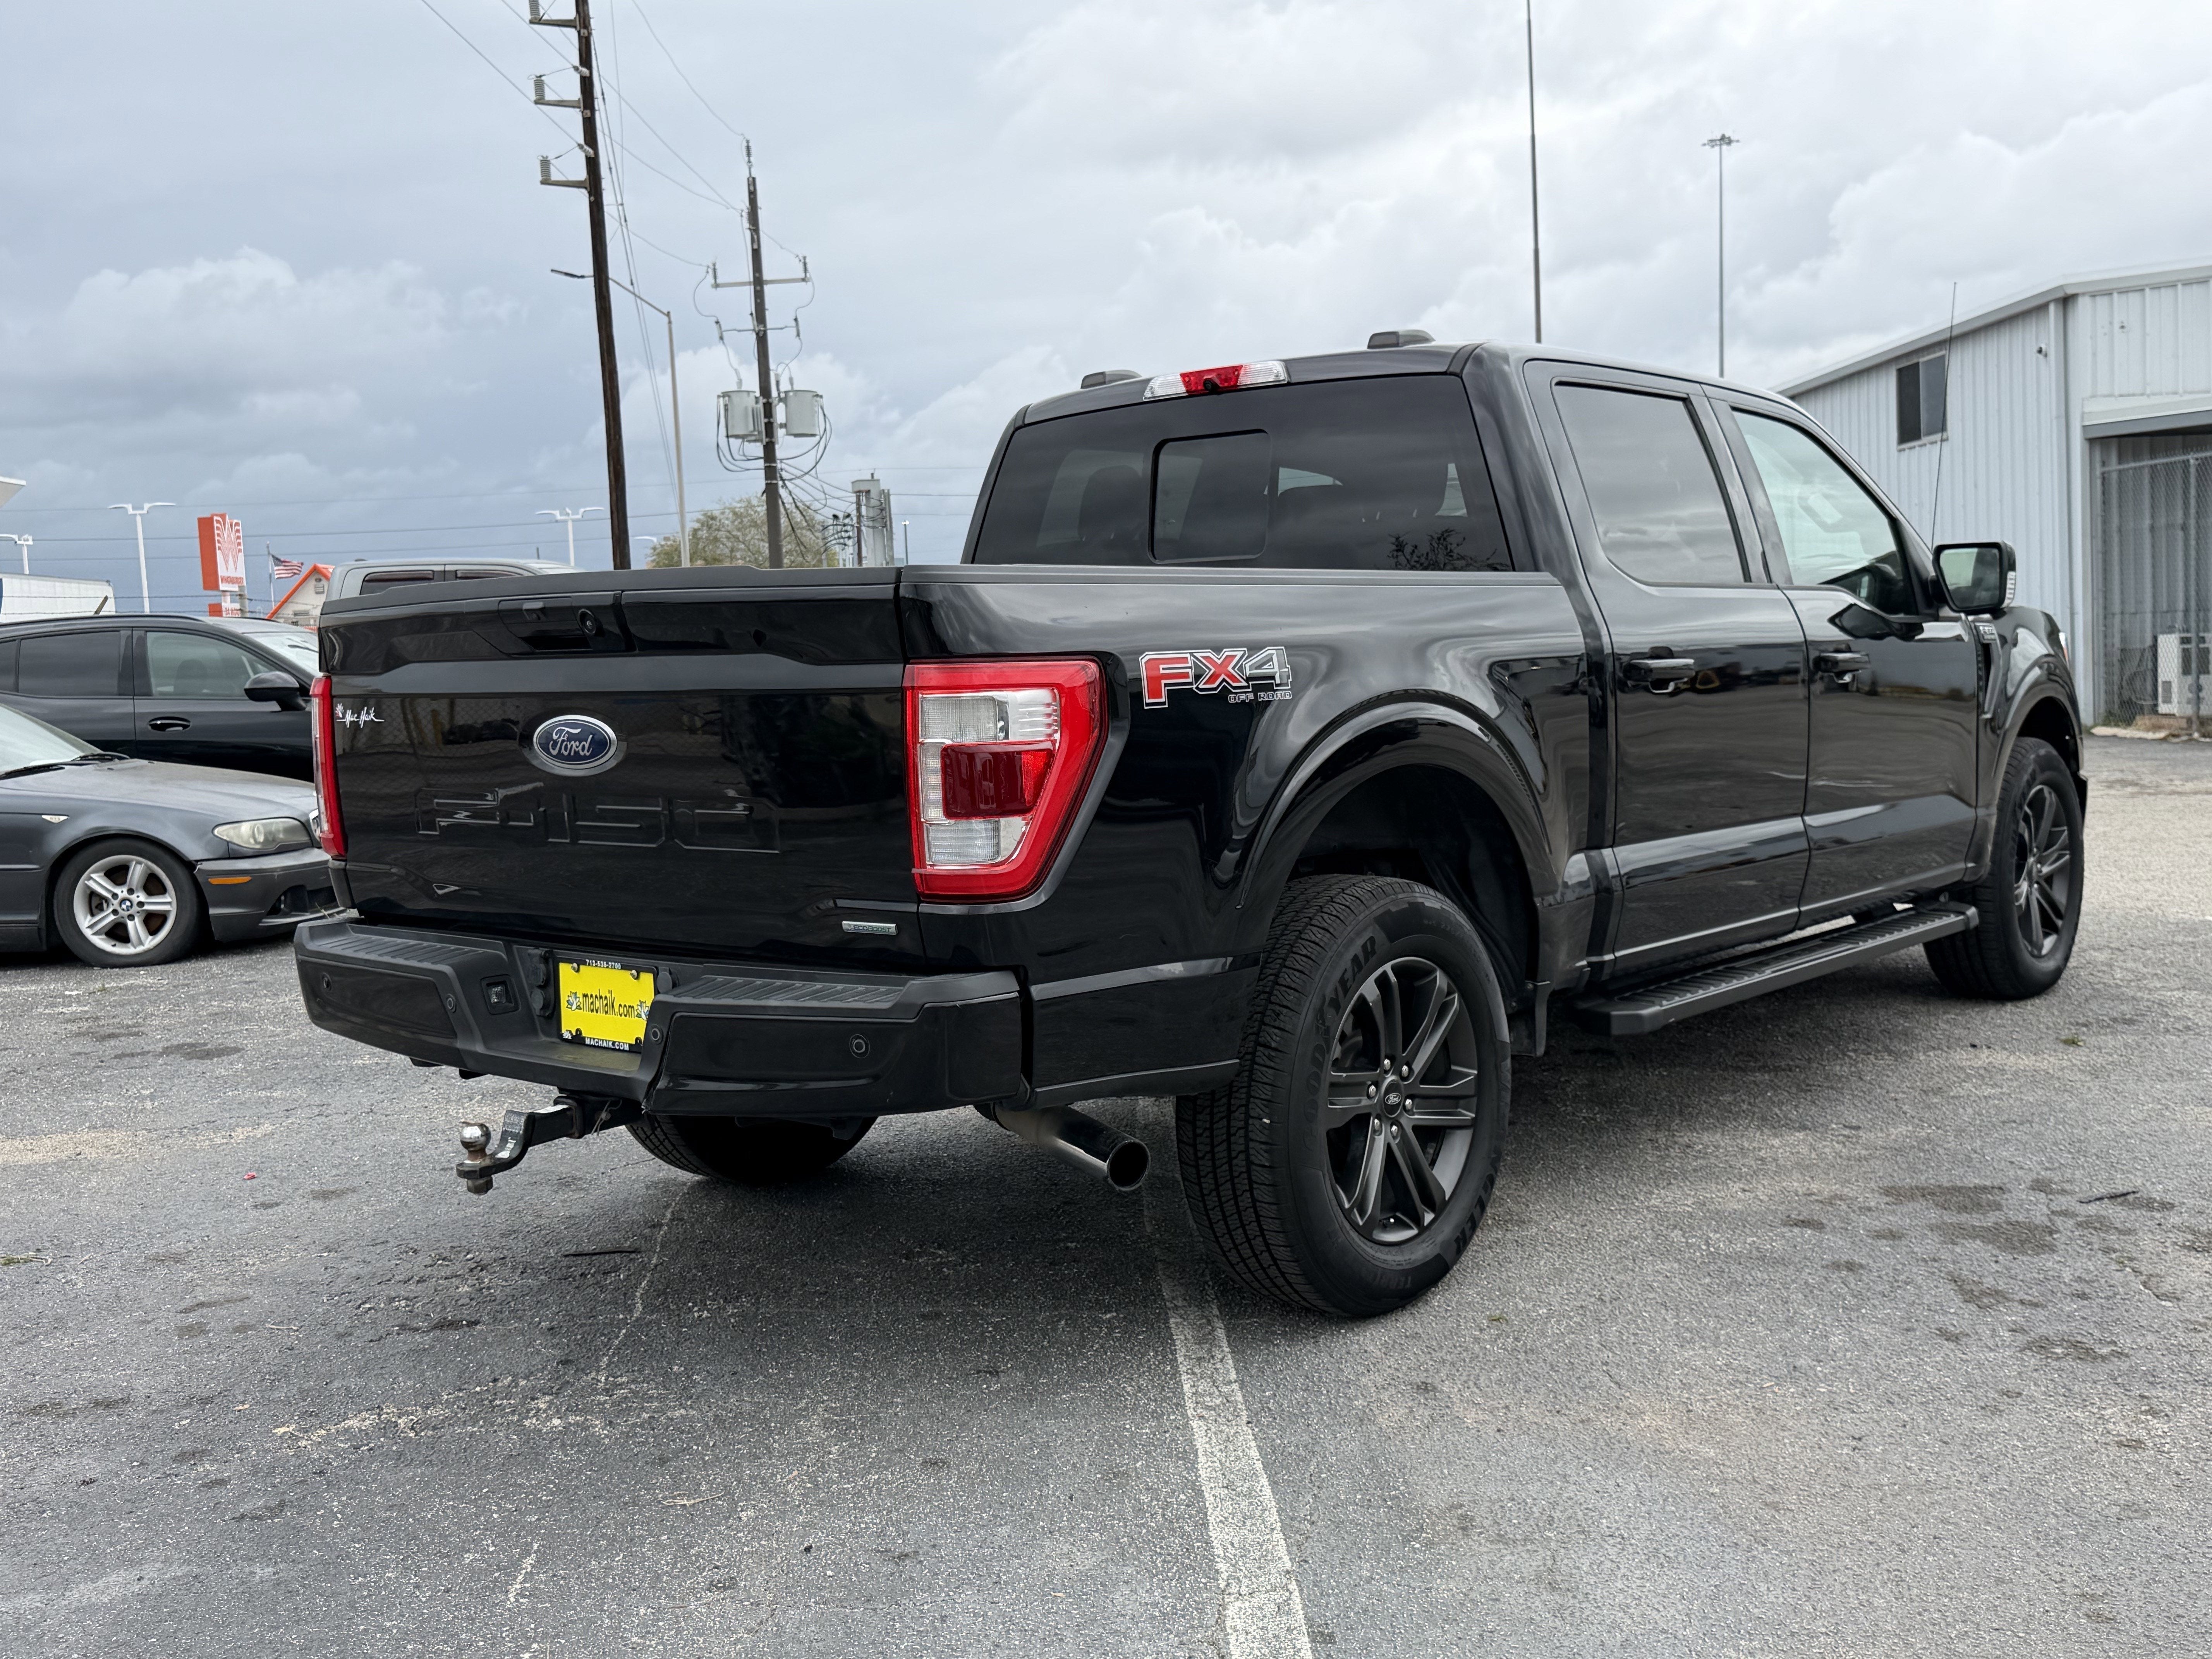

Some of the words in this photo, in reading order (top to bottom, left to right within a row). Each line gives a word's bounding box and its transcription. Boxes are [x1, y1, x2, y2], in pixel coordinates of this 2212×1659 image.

[1139, 646, 1292, 709] FX4
[1228, 693, 1254, 703] OFF
[1258, 691, 1292, 701] ROAD
[549, 727, 592, 756] Ford
[582, 988, 635, 1018] machaik.com
[585, 1037, 629, 1051] MACHAIK.COM
[1388, 1095, 1399, 1103] Ford
